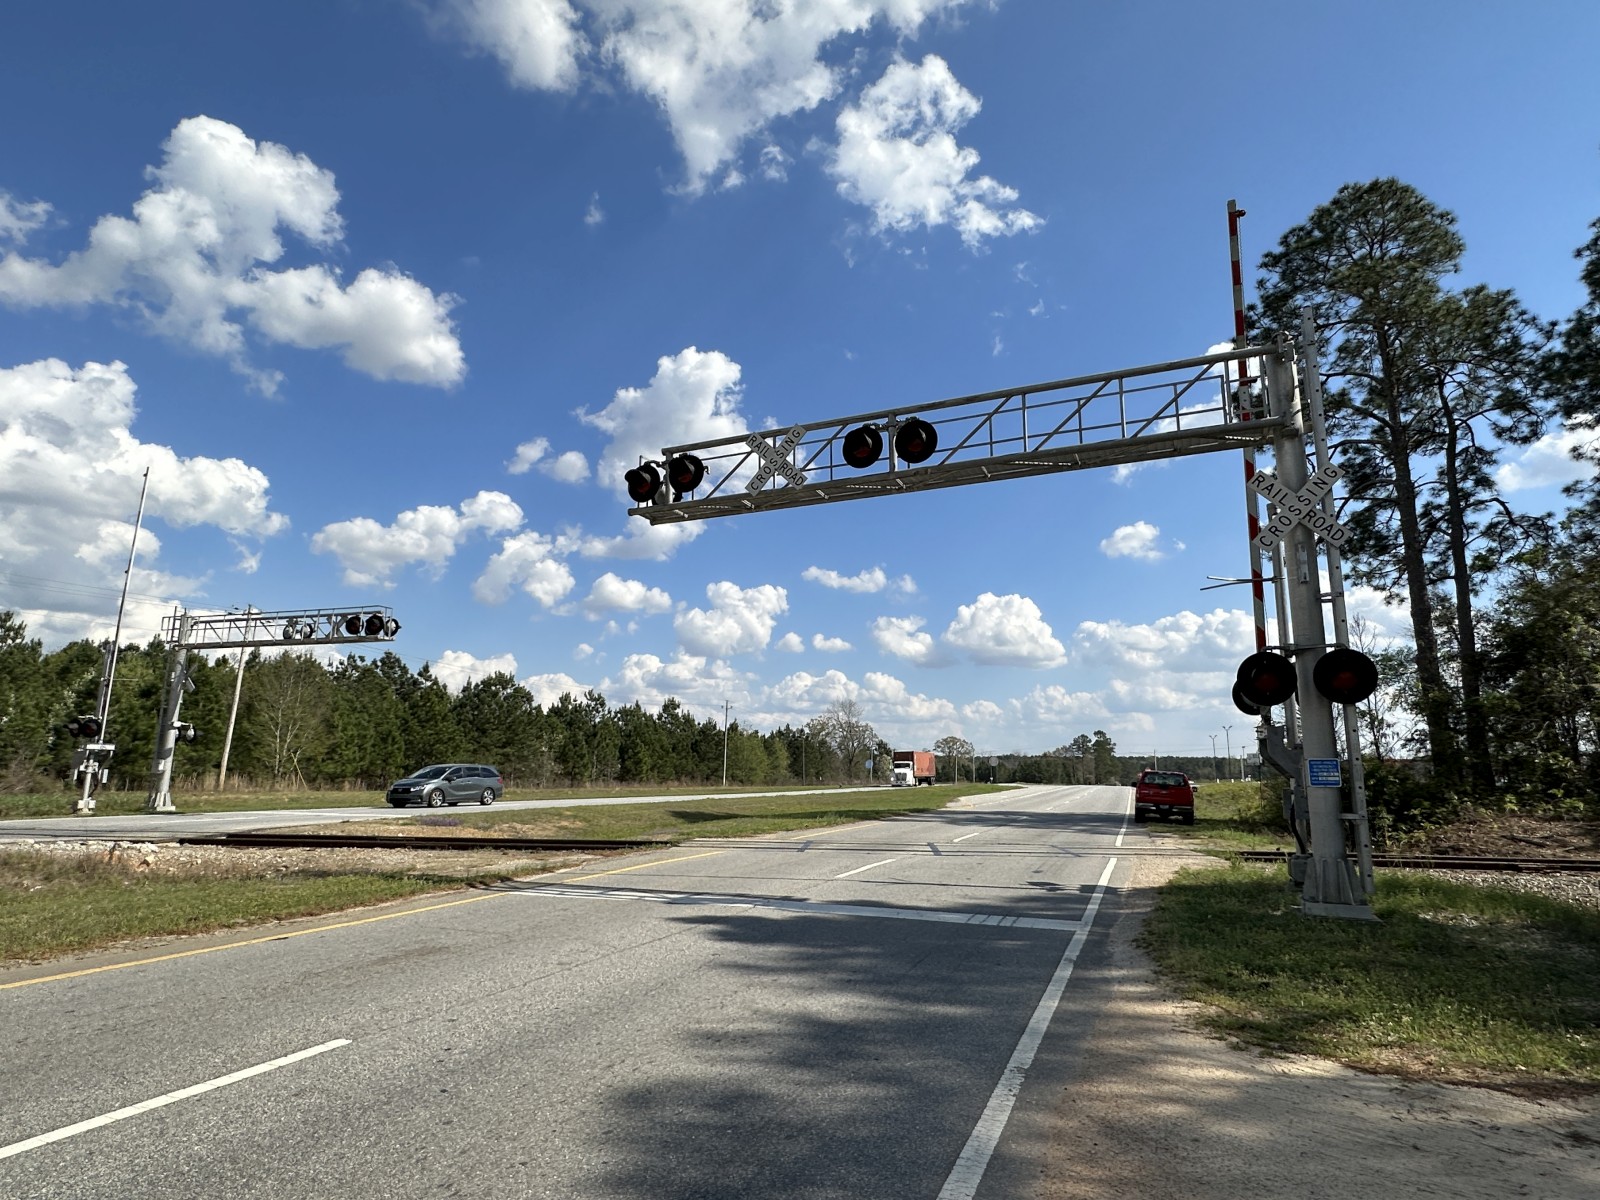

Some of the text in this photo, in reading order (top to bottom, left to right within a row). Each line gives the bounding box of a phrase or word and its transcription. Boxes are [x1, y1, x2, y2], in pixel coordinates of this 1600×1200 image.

[748, 435, 804, 486] RAIL ROAD
[751, 429, 801, 491] CROSSING
[1252, 475, 1344, 541] RAIL ROAD
[1259, 467, 1337, 547] CROSSING
